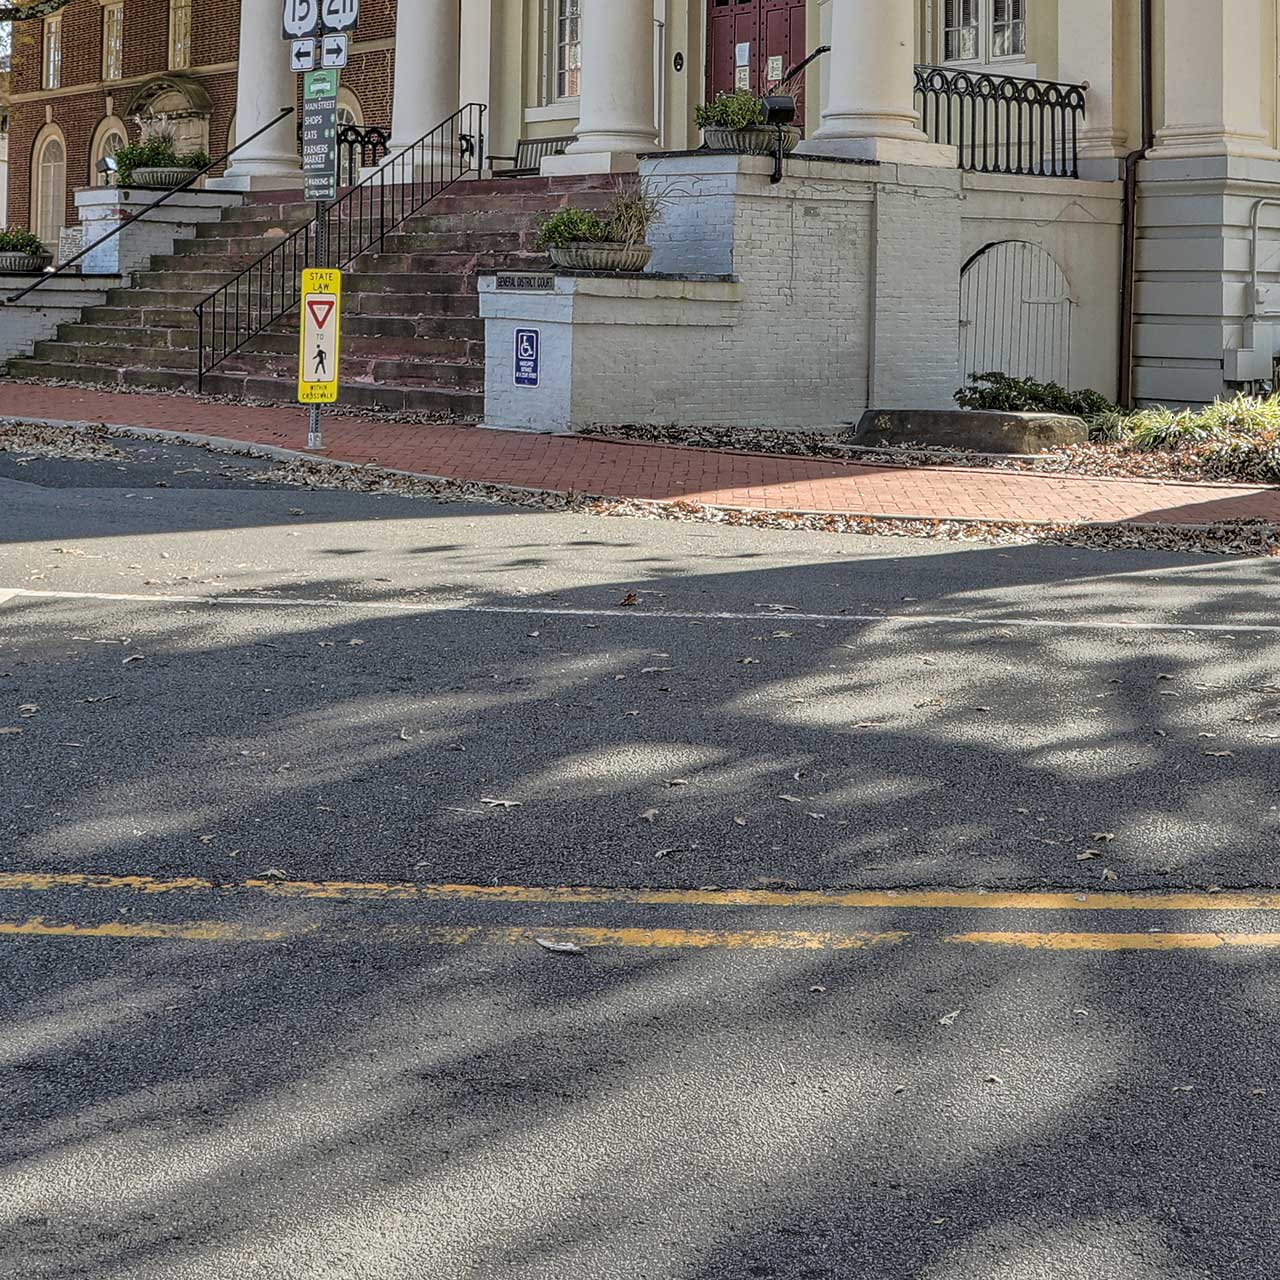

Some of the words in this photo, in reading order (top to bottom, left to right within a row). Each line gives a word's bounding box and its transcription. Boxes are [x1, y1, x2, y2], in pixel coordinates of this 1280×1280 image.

[304, 102, 318, 111] MAIN
[318, 100, 336, 110] STREET
[304, 115, 323, 126] SHOPS
[304, 130, 318, 140] EATS
[304, 144, 328, 154] FARMERS
[303, 154, 326, 164] MARKET
[310, 272, 333, 281] STATE
[312, 283, 329, 291] LAW
[537, 276, 553, 289] COURT
[302, 391, 333, 400] CROSSWALK
